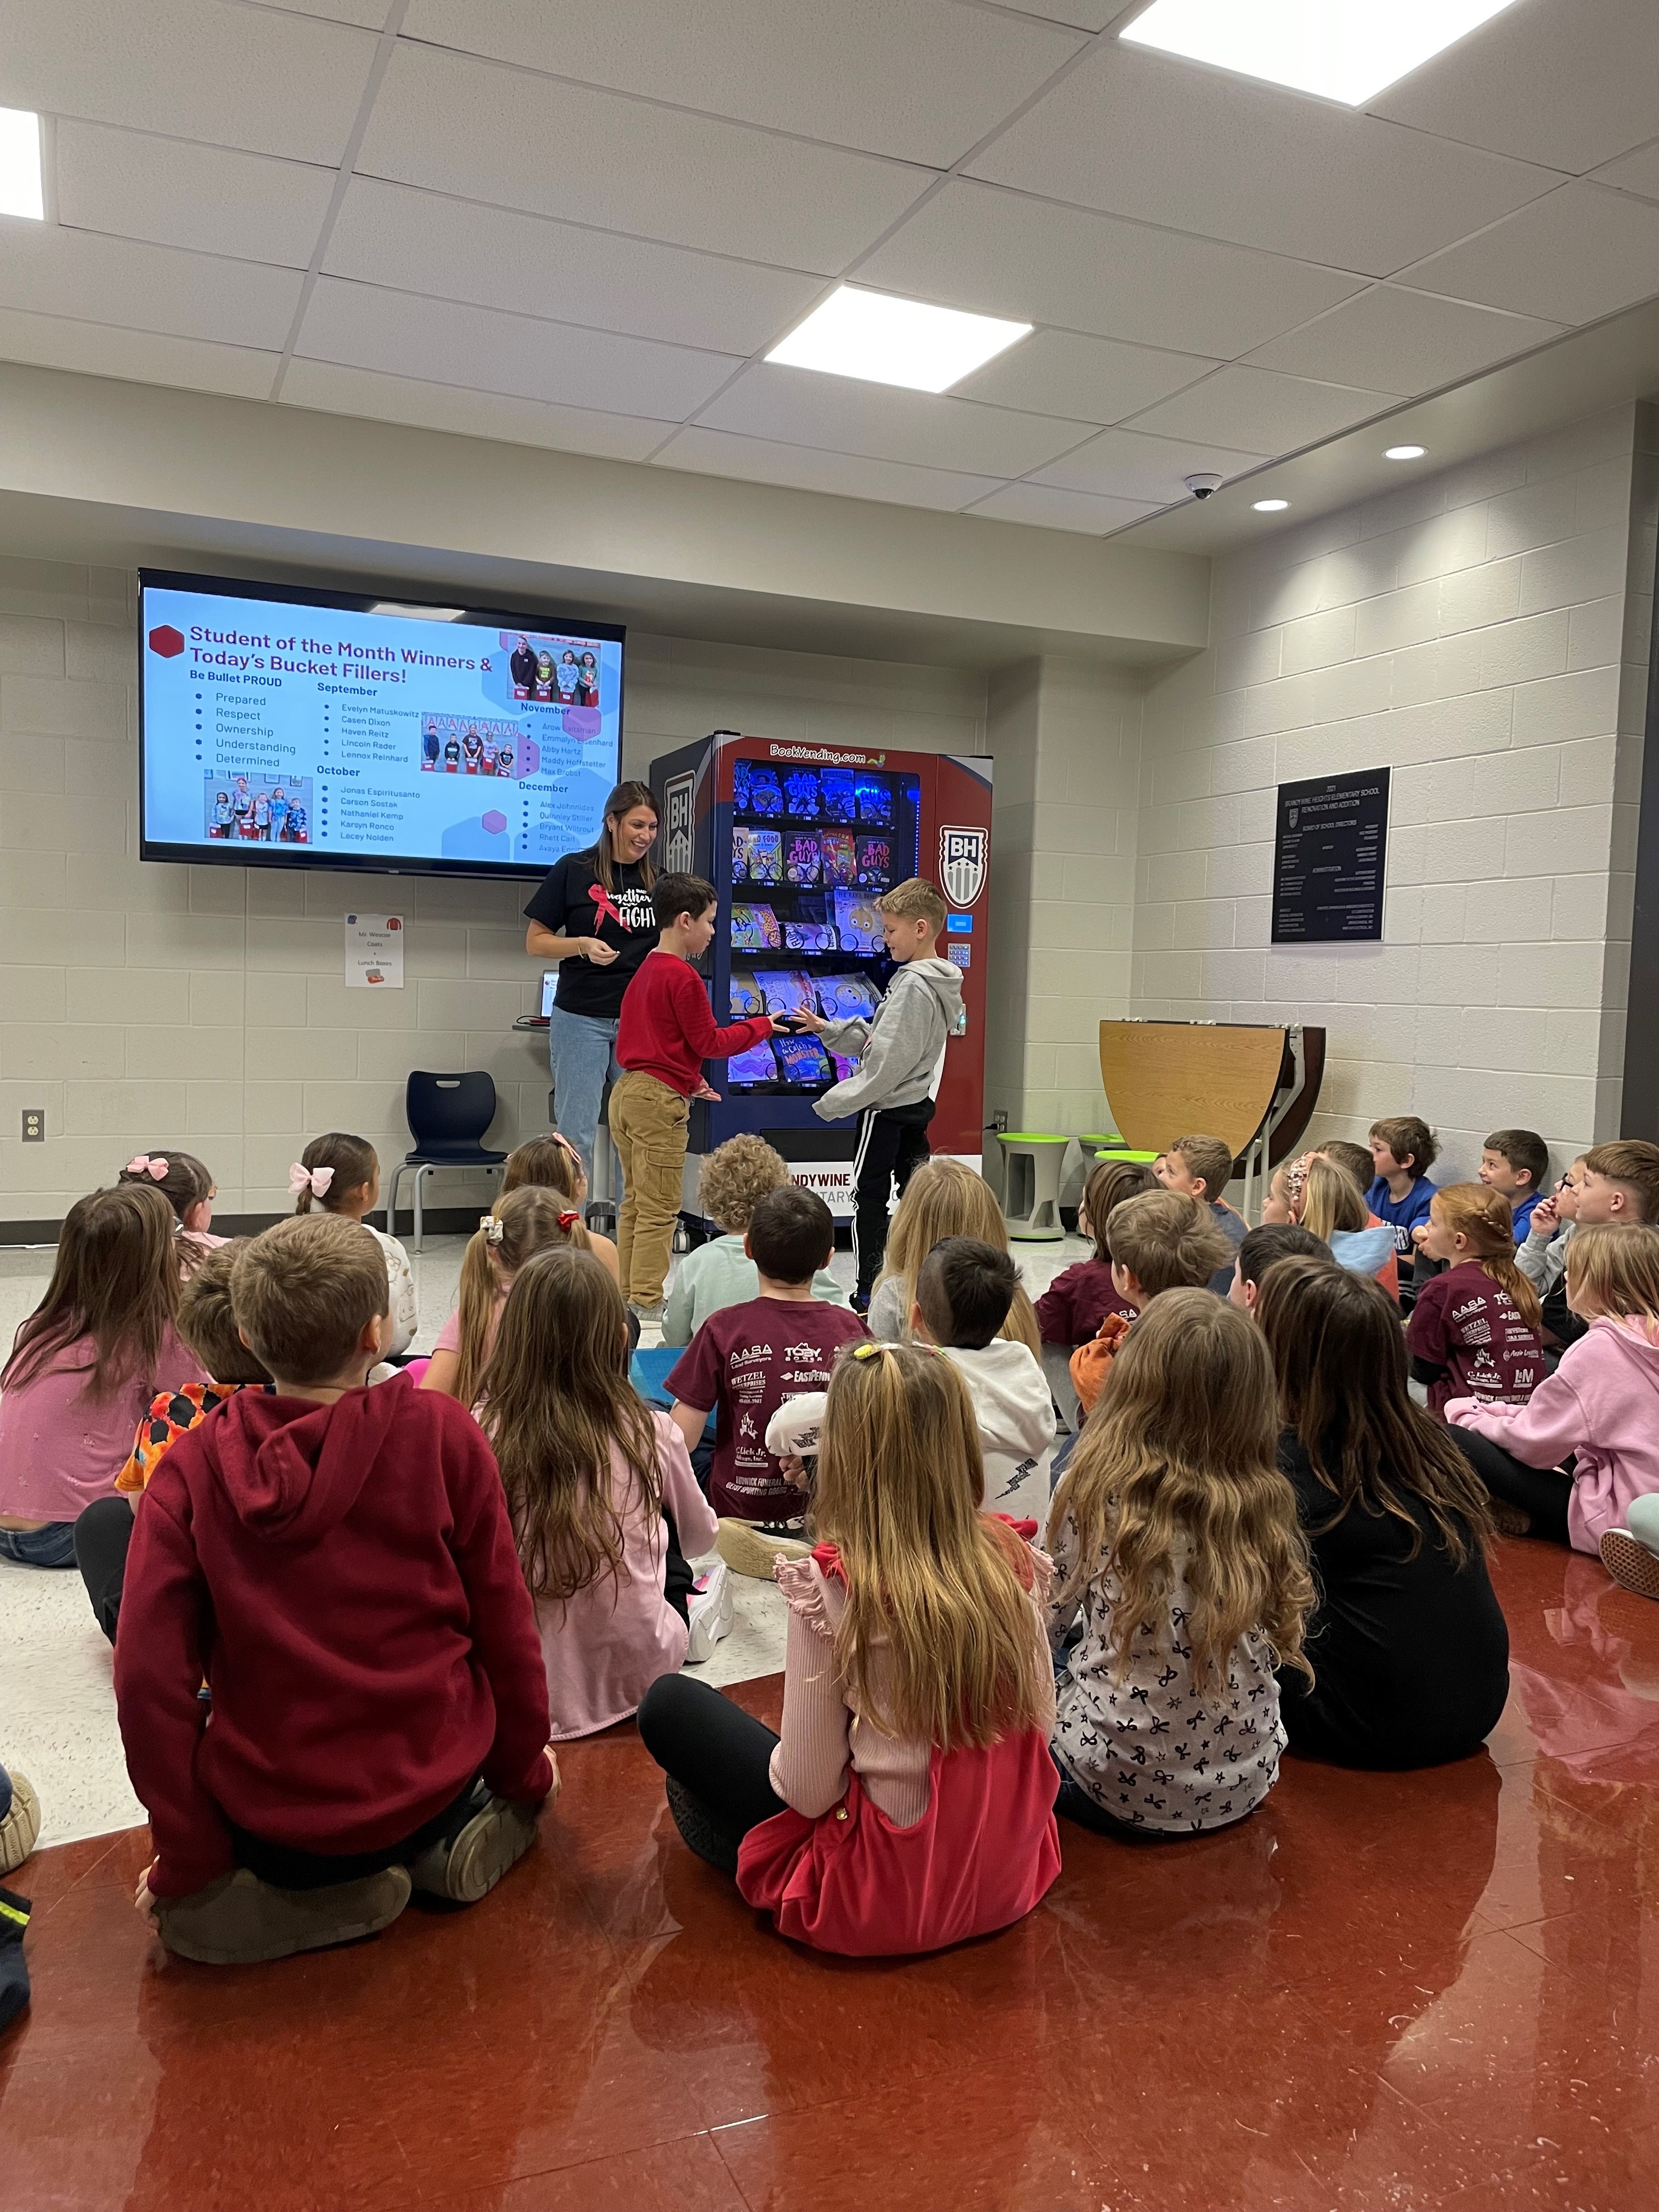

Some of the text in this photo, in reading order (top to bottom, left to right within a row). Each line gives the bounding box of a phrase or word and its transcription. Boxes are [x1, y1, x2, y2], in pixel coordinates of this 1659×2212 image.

[190, 626, 493, 672] Student of the Month Winners &
[190, 647, 407, 683] Today's Bucket Fillers!
[190, 669, 283, 687] Be Bullet PROUD
[317, 682, 378, 696] September
[216, 692, 266, 706] Prepared
[216, 707, 261, 721] Respect
[342, 704, 419, 718] Evelyn Matuskowitz
[521, 702, 571, 715] November
[342, 715, 391, 726] Casen Dixon
[216, 723, 274, 738] Ownership
[342, 727, 389, 738] Haven Reitz
[341, 739, 397, 750] Lincoln Rader
[542, 733, 575, 744] Emmalyn
[216, 738, 296, 756] Understanding
[541, 745, 560, 754] Abby
[341, 751, 408, 763] Lennox Reinhard
[770, 744, 866, 764] BookVending.com
[216, 753, 280, 768] Determined
[541, 756, 606, 768] Maddy Hoffstetter
[317, 765, 360, 776] October
[541, 767, 555, 775] Max
[793, 773, 817, 785] BAD
[341, 786, 420, 798] Jonas Espiritusanto
[519, 781, 569, 793] December
[788, 785, 818, 798] GUYS
[1360, 787, 1380, 797] SCHOOL
[341, 797, 398, 808] Carson Sostak
[341, 809, 404, 820] Nathaniel Kemp
[670, 792, 689, 830] BH
[341, 821, 394, 831] Karsyn Ronco
[540, 822, 563, 831] Bryant
[341, 832, 394, 842] Lacey Nolden
[763, 835, 779, 843] FOOD
[795, 840, 817, 852] BAD
[868, 844, 890, 856] BAD
[951, 837, 977, 857] BH
[861, 854, 890, 868] GUYS
[619, 906, 656, 928] FIGHT
[779, 1039, 795, 1048] How
[788, 1042, 807, 1053] Catch
[785, 1047, 820, 1065] MONSTER
[1119, 1308, 1137, 1318] SA
[1452, 1296, 1486, 1319] AASA
[730, 1344, 773, 1363] AASA
[784, 1347, 822, 1357] TOBY
[731, 1371, 766, 1385] WETZEL
[756, 1448, 766, 1457] Jr.
[758, 1477, 782, 1487] FUNERAL
[725, 1482, 742, 1492] GEIST
[741, 1486, 767, 1496] SPORTING
